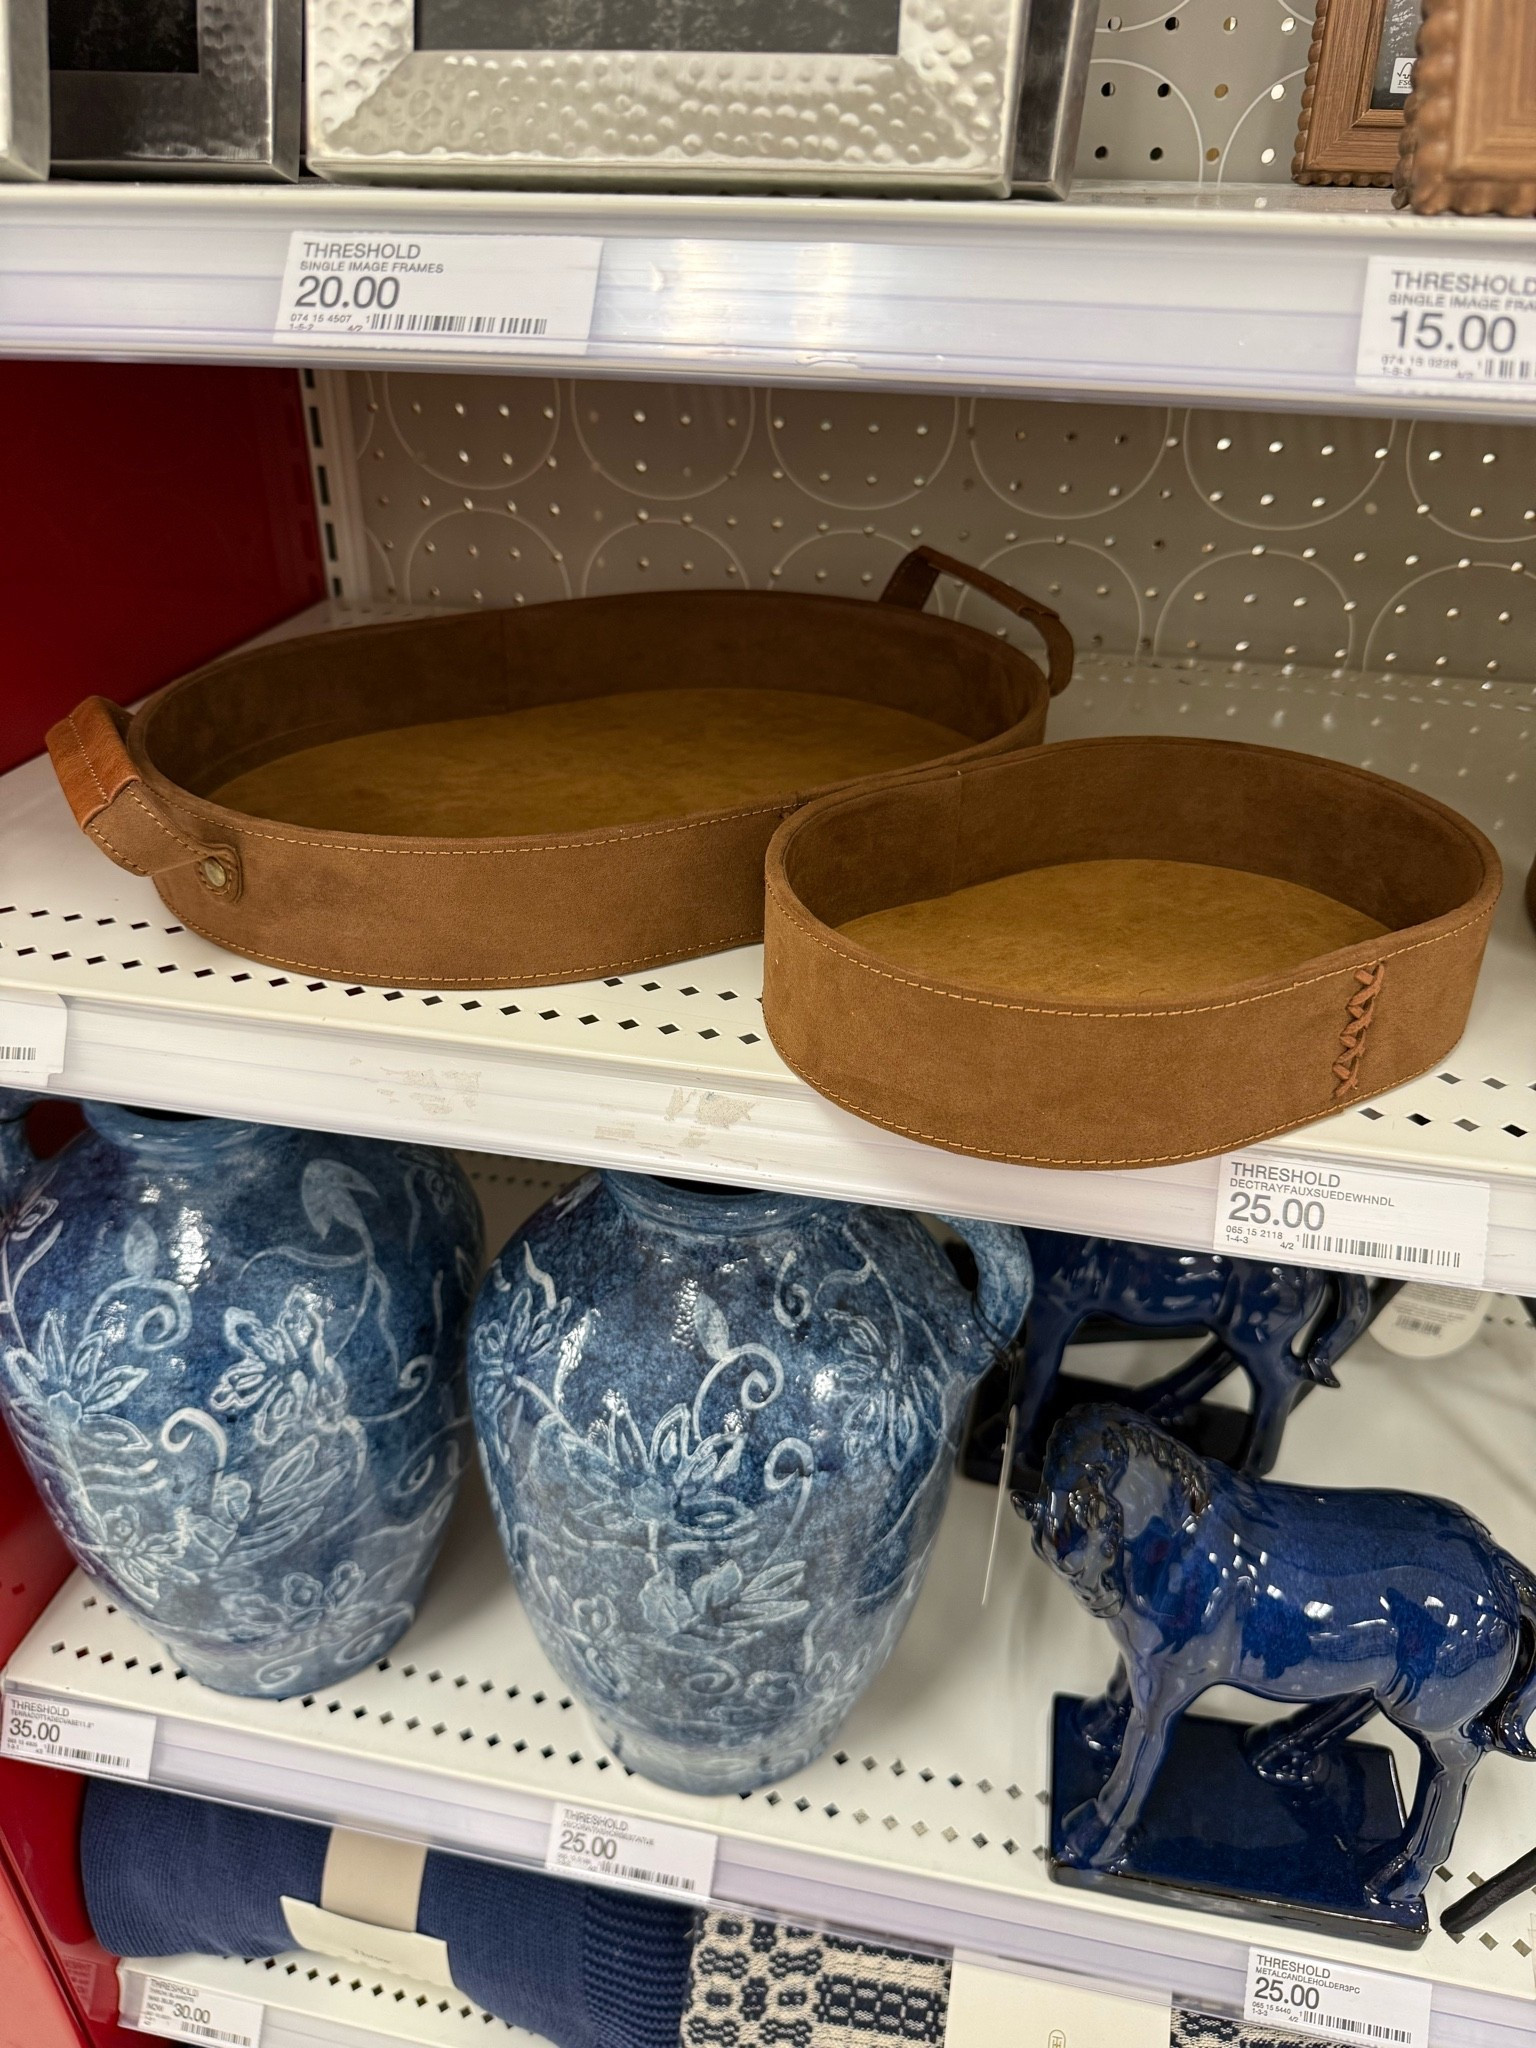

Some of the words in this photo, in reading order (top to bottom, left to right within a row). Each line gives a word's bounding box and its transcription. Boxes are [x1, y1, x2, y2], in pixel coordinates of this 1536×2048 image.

[303, 241, 422, 260] THRESHOLD
[300, 261, 345, 272] SINGLE
[349, 262, 389, 273] IMAGE
[392, 262, 444, 274] FRAMES
[294, 275, 401, 309] 20.00
[1391, 269, 1536, 296] THRESHOLD
[1388, 294, 1446, 308] SINGLE
[1449, 297, 1502, 310] IMAGE
[290, 313, 309, 322] 074
[313, 314, 325, 323] 15
[326, 314, 352, 323] 4507
[1390, 310, 1517, 353] 15.00
[1231, 1161, 1341, 1188] THRESHOLD
[1229, 1178, 1396, 1207] DECTRAYFAUXSUEDEWHNDL
[1228, 1191, 1325, 1231] 25.00
[1225, 1225, 1244, 1235] 065
[1246, 1227, 1258, 1236] 15
[1260, 1229, 1283, 1240] 2118
[1225, 1234, 1249, 1244] 1-4-3
[1280, 1241, 1295, 1250] 4/2
[11, 1699, 70, 1717] THRESHOLD
[9, 1717, 60, 1742] 35.00
[563, 1808, 629, 1832] THRESHOLD
[559, 1829, 618, 1860] 25.00
[1256, 1954, 1331, 1979] THRESHOLD
[150, 1978, 199, 1998] THRESHOLD
[1254, 1976, 1320, 2010] 25.00
[1255, 1966, 1361, 1995] METALCANDLEHOLDER3PC
[173, 2003, 211, 2025] 30.00
